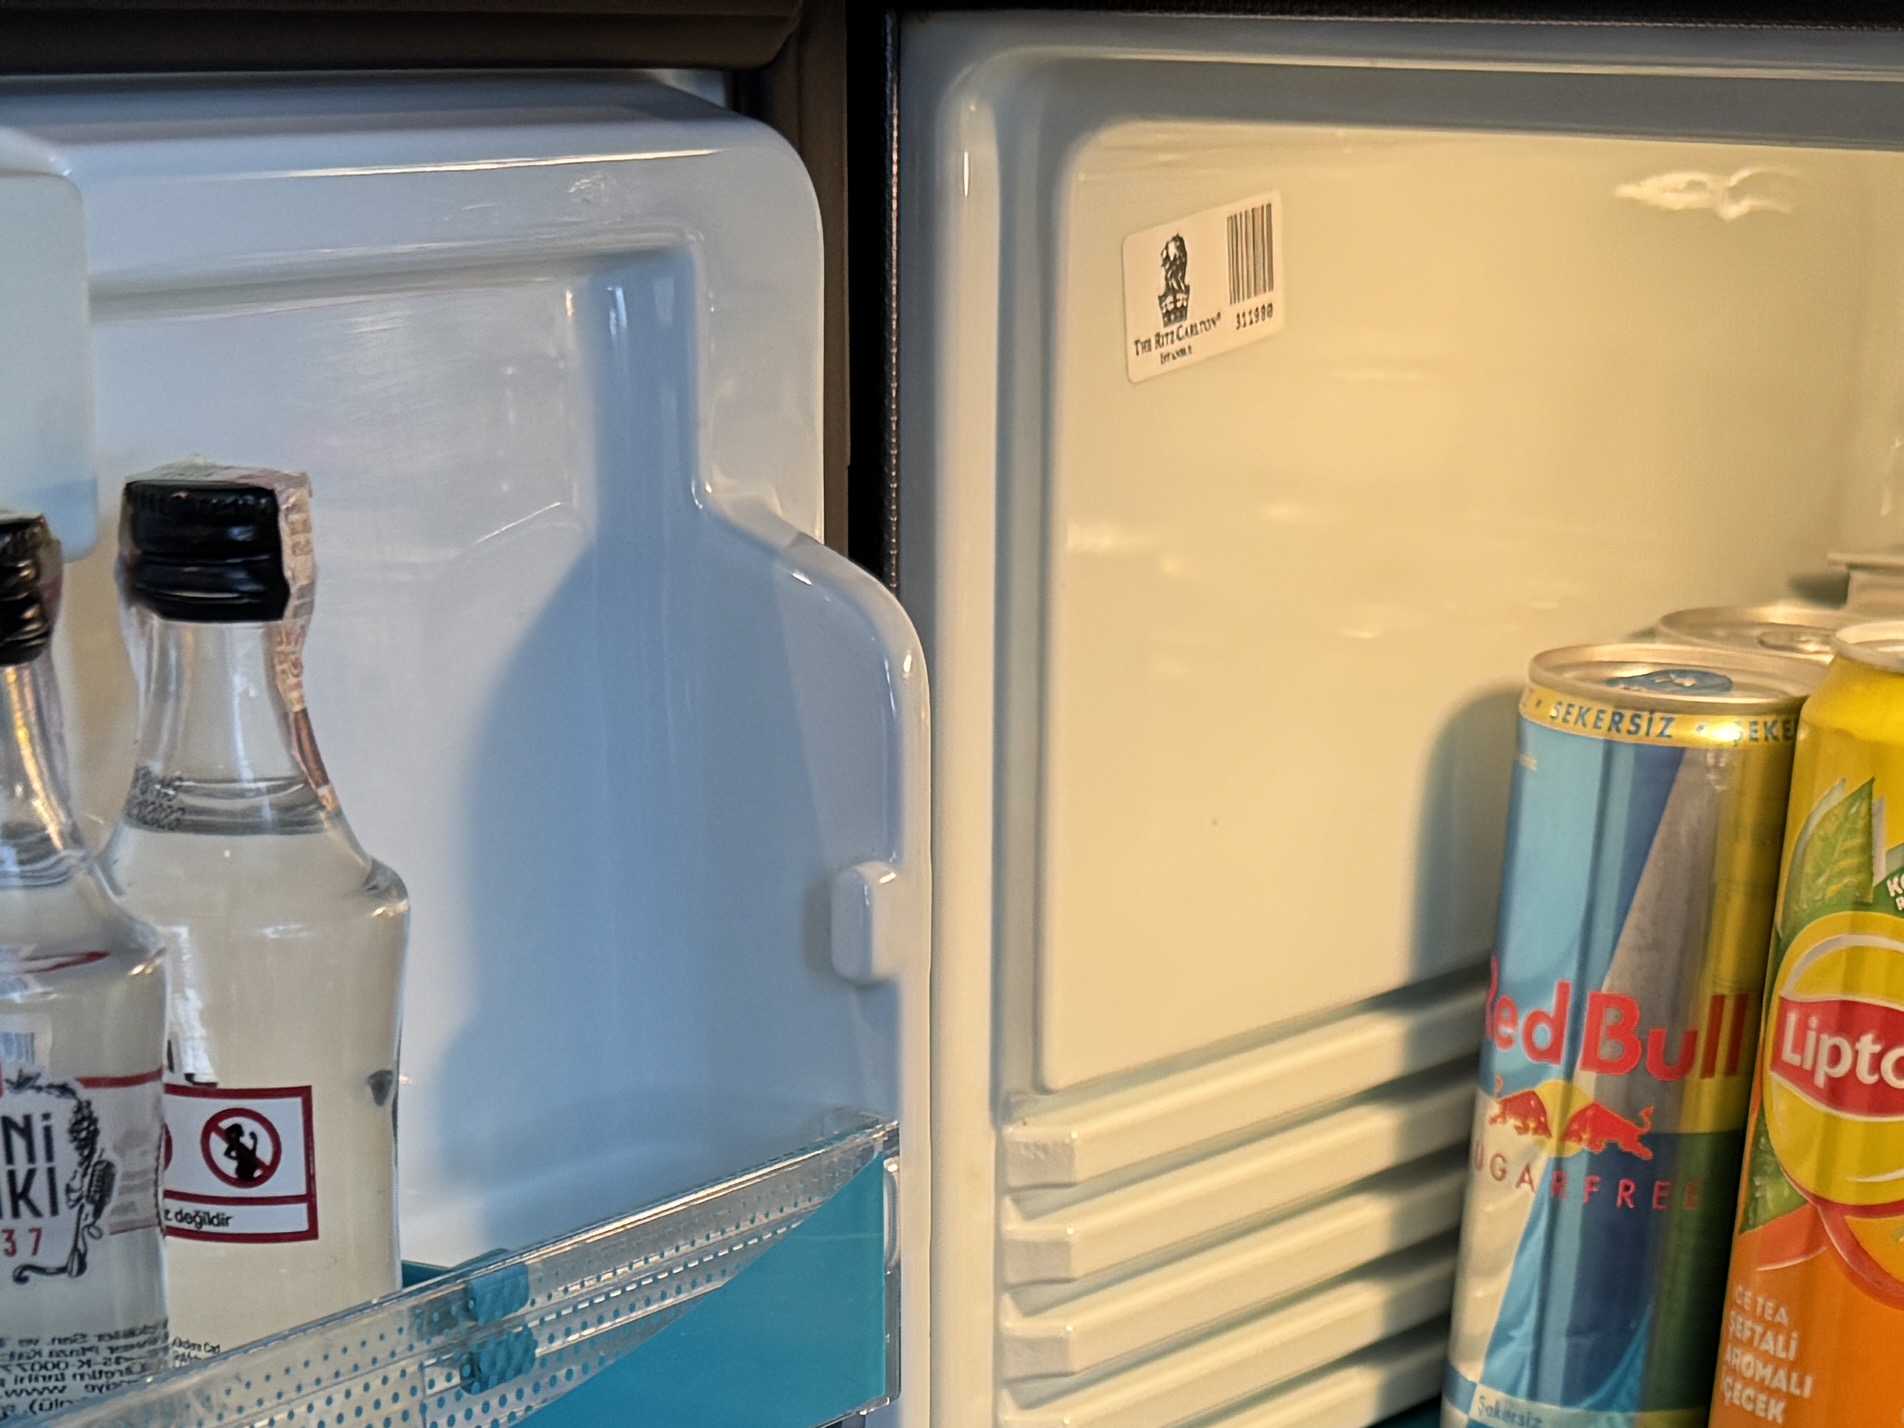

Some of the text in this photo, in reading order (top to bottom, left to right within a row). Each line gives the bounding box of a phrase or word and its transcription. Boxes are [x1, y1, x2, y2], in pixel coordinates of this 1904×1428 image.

[1549, 700, 1795, 748] ŞEKERSİZ ŞEKE
[1580, 990, 1750, 1082] Bull
[1473, 1139, 1704, 1211] UGARFREE
[173, 1207, 234, 1229] değildir
